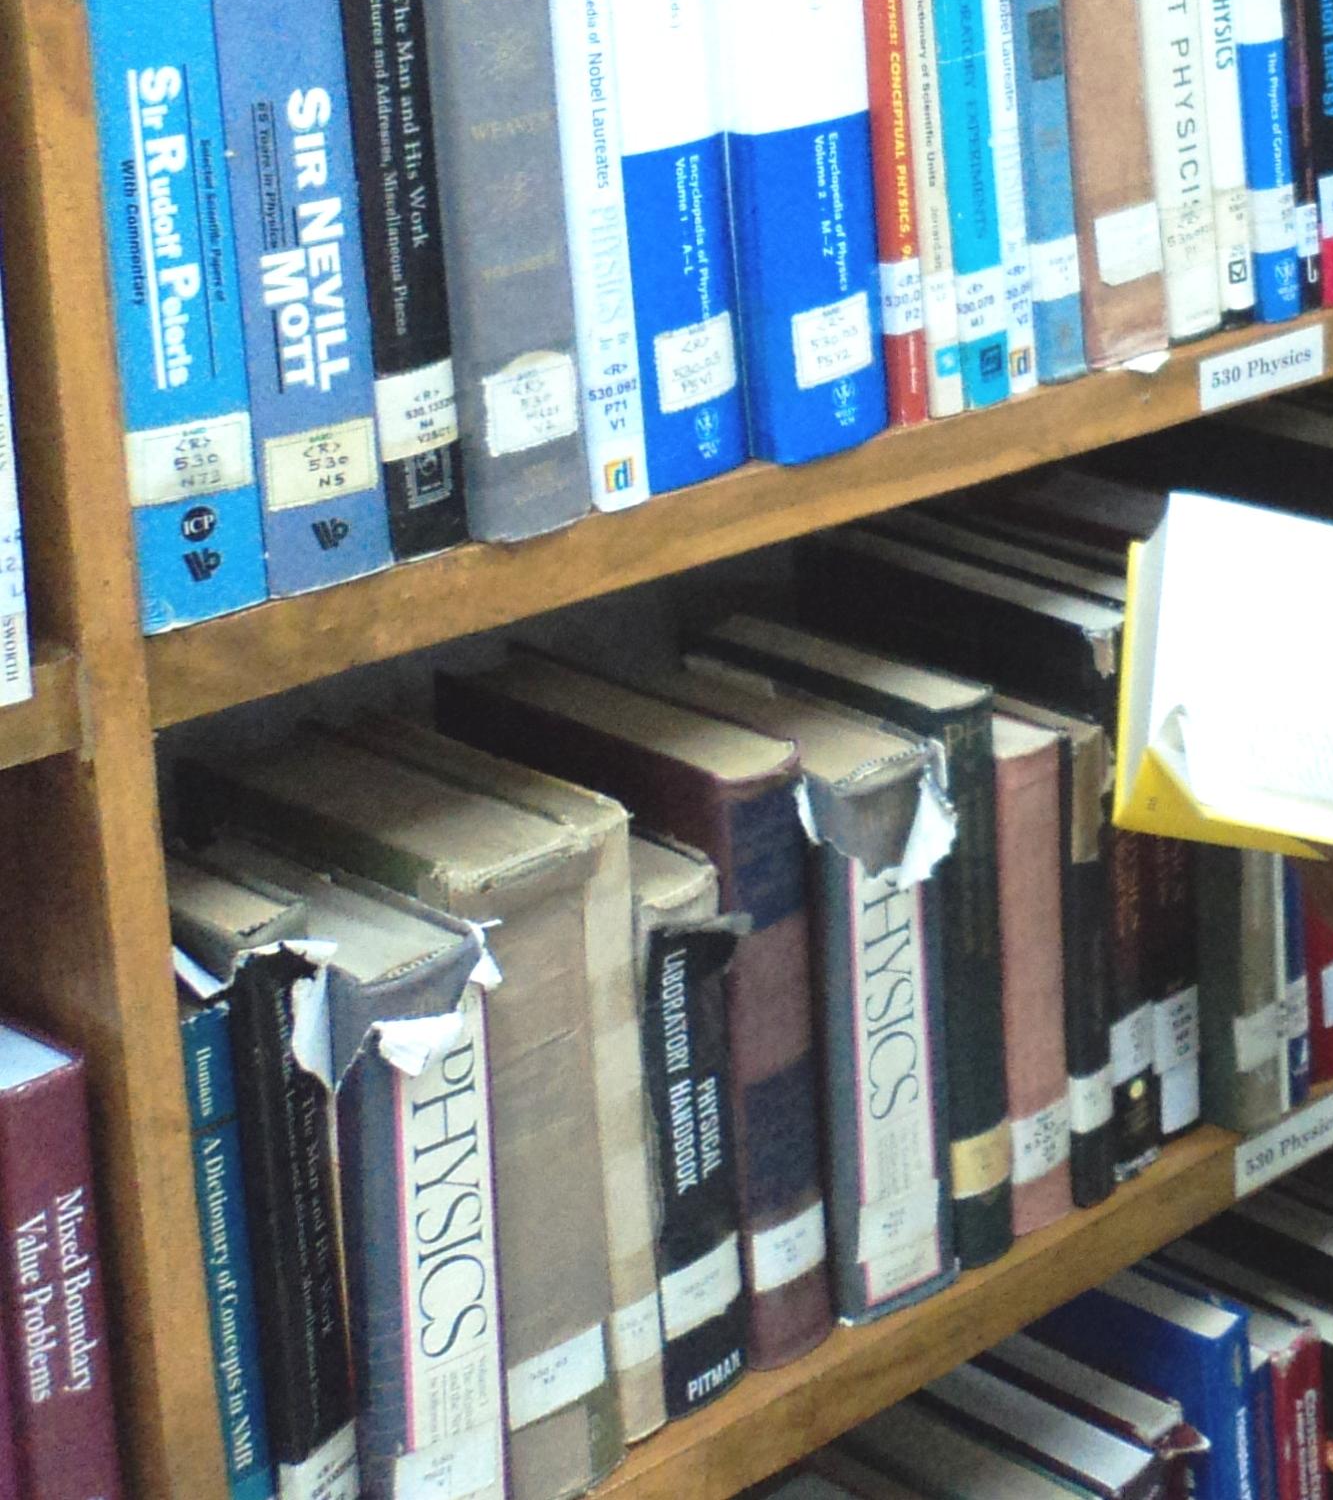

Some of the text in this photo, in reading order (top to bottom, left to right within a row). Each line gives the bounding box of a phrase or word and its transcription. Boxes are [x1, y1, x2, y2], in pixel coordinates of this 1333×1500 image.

[396, 37, 413, 83] Man
[587, 51, 606, 102] Nobel
[1001, 39, 1017, 113] Laureates
[1266, 51, 1280, 122] The Physics
[400, 88, 417, 131] and
[403, 134, 423, 181] His
[590, 103, 610, 191] Laureates
[888, 50, 912, 238] CONCEPTUAL PHYSICS,
[921, 80, 935, 149] Scientific
[139, 65, 188, 269] Sir Rudolf
[674, 157, 687, 213] Volume
[688, 153, 706, 249] Encyclopedia
[813, 134, 826, 189] Volume
[964, 99, 989, 241] EXPERIMENTS
[119, 159, 147, 308] With Commentary
[286, 86, 352, 394] SIR NEVILL
[406, 186, 431, 250] Work
[826, 130, 849, 293] Encyclopedia Physics
[259, 248, 316, 388] MOTT
[1210, 347, 1313, 390] 530 Physics
[861, 878, 920, 1121] HYSICS
[660, 948, 699, 1195] LABORATORY HANDBOOK
[697, 1076, 723, 1176] PHYSICAL
[1244, 1150, 1275, 1176] 530
[410, 1038, 490, 1360] PHYSICS
[13, 1211, 52, 1404] Value Problems
[54, 1186, 99, 1393] Mixed Boundary
[202, 1156, 257, 1472] Dictionary of Concepts NMR
[686, 1347, 742, 1401] PITMAN
